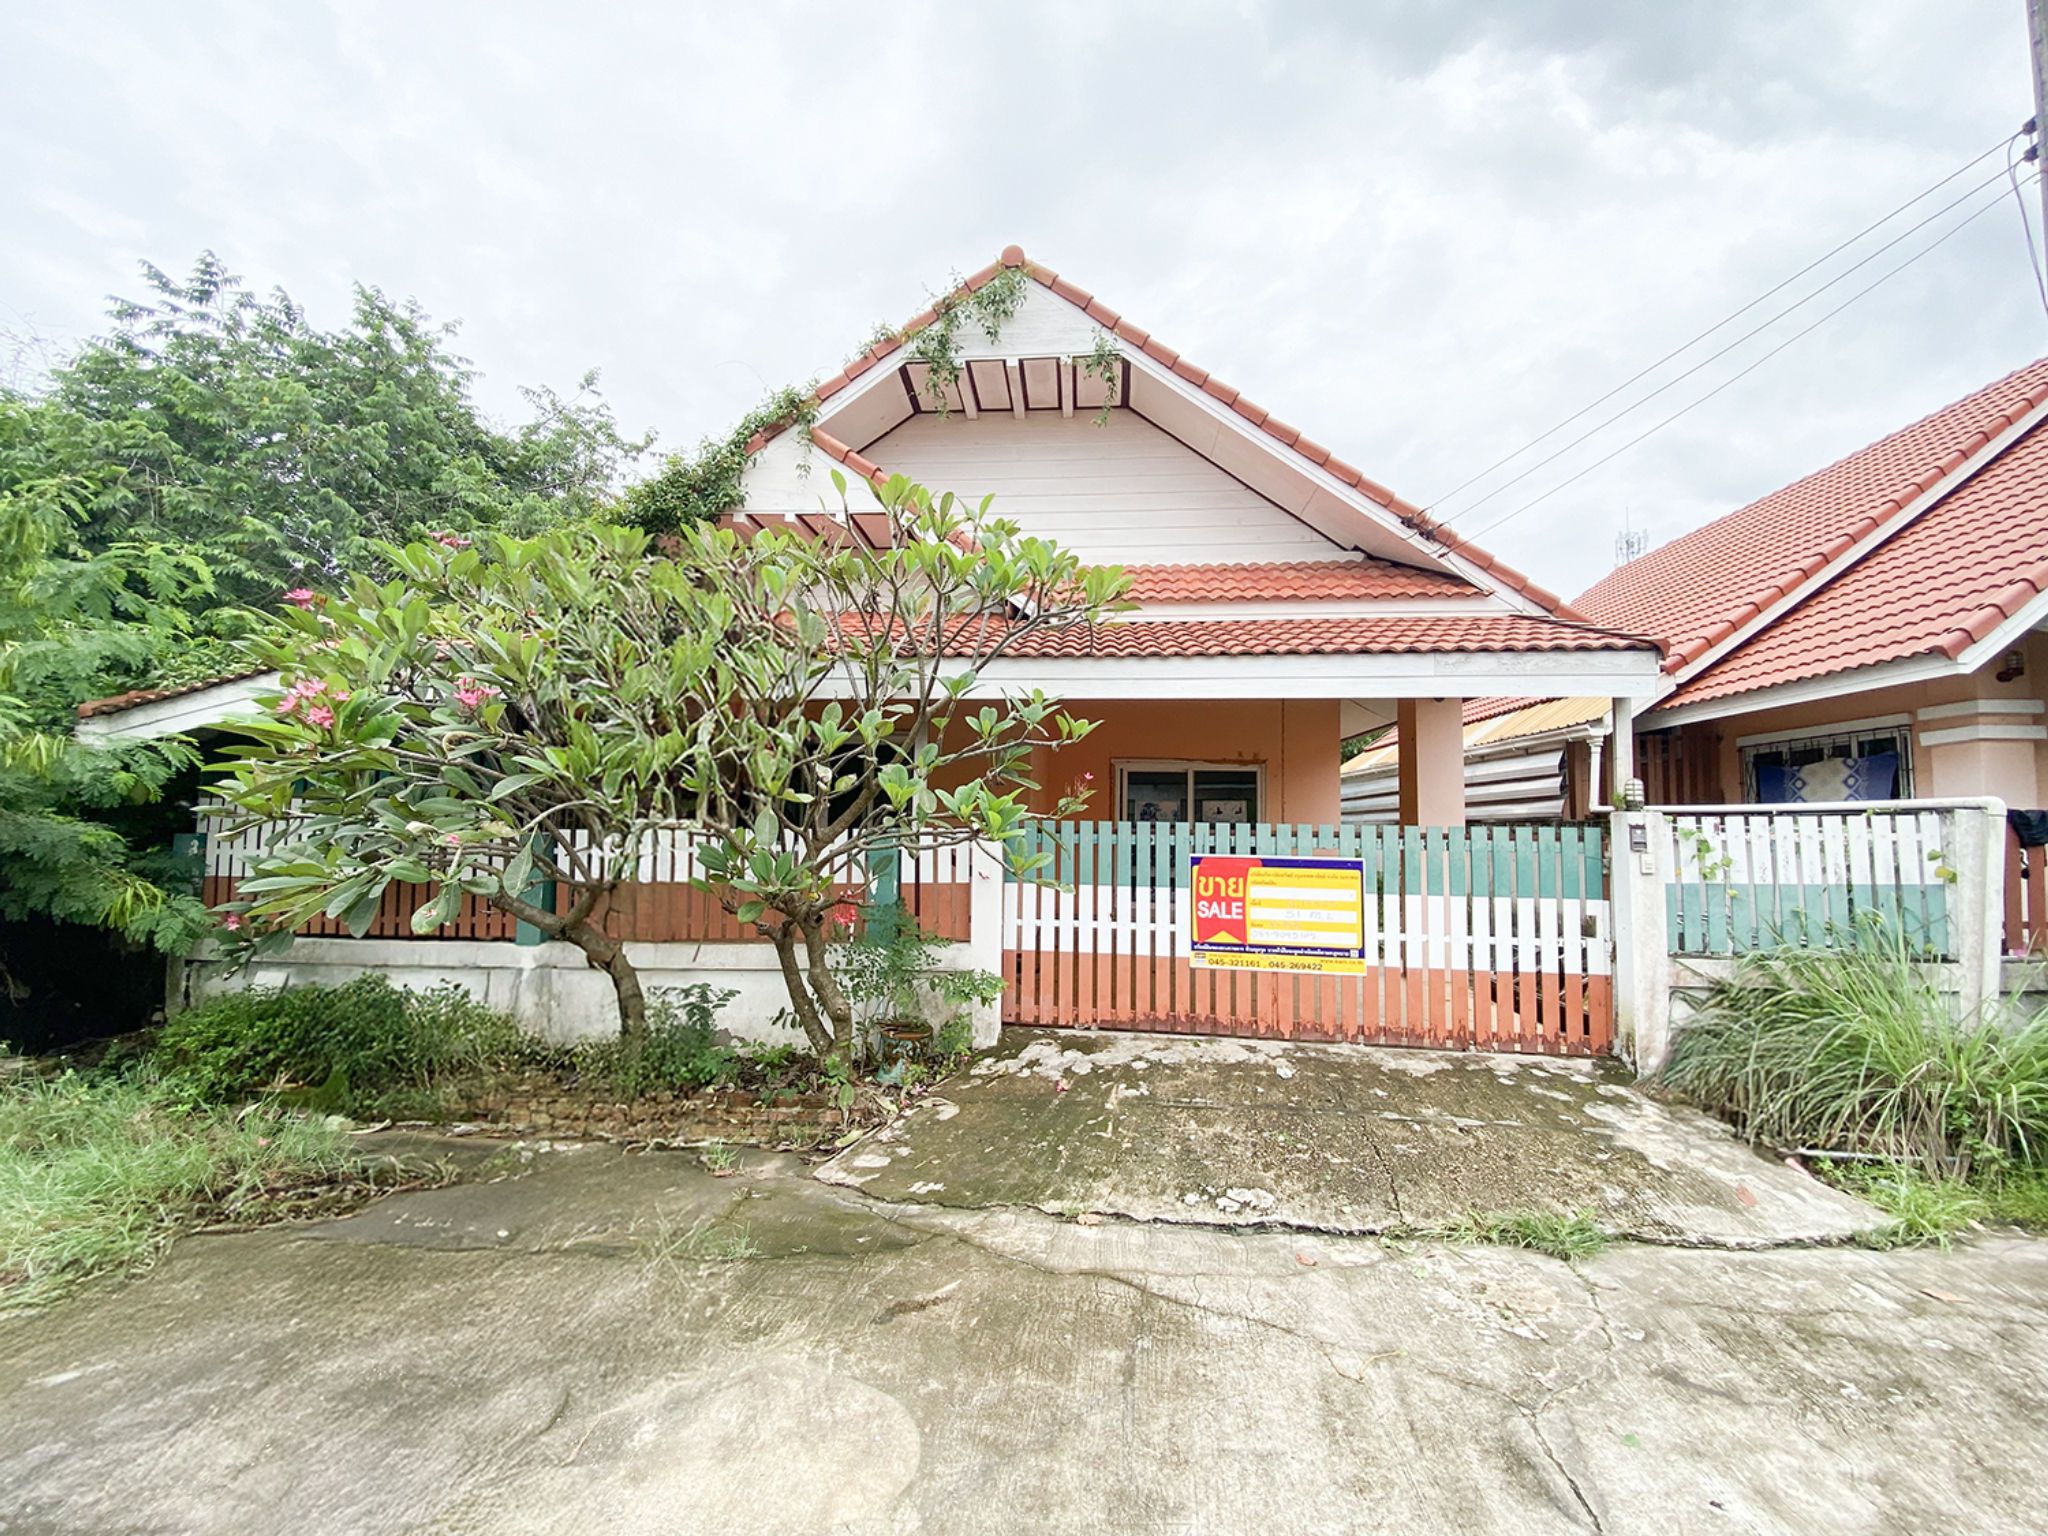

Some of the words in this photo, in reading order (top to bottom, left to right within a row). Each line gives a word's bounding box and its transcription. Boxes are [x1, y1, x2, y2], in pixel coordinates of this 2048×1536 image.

[1199, 876, 1244, 898] ขาย
[1197, 900, 1244, 919] SALE
[1208, 958, 1260, 968] 045-321161
